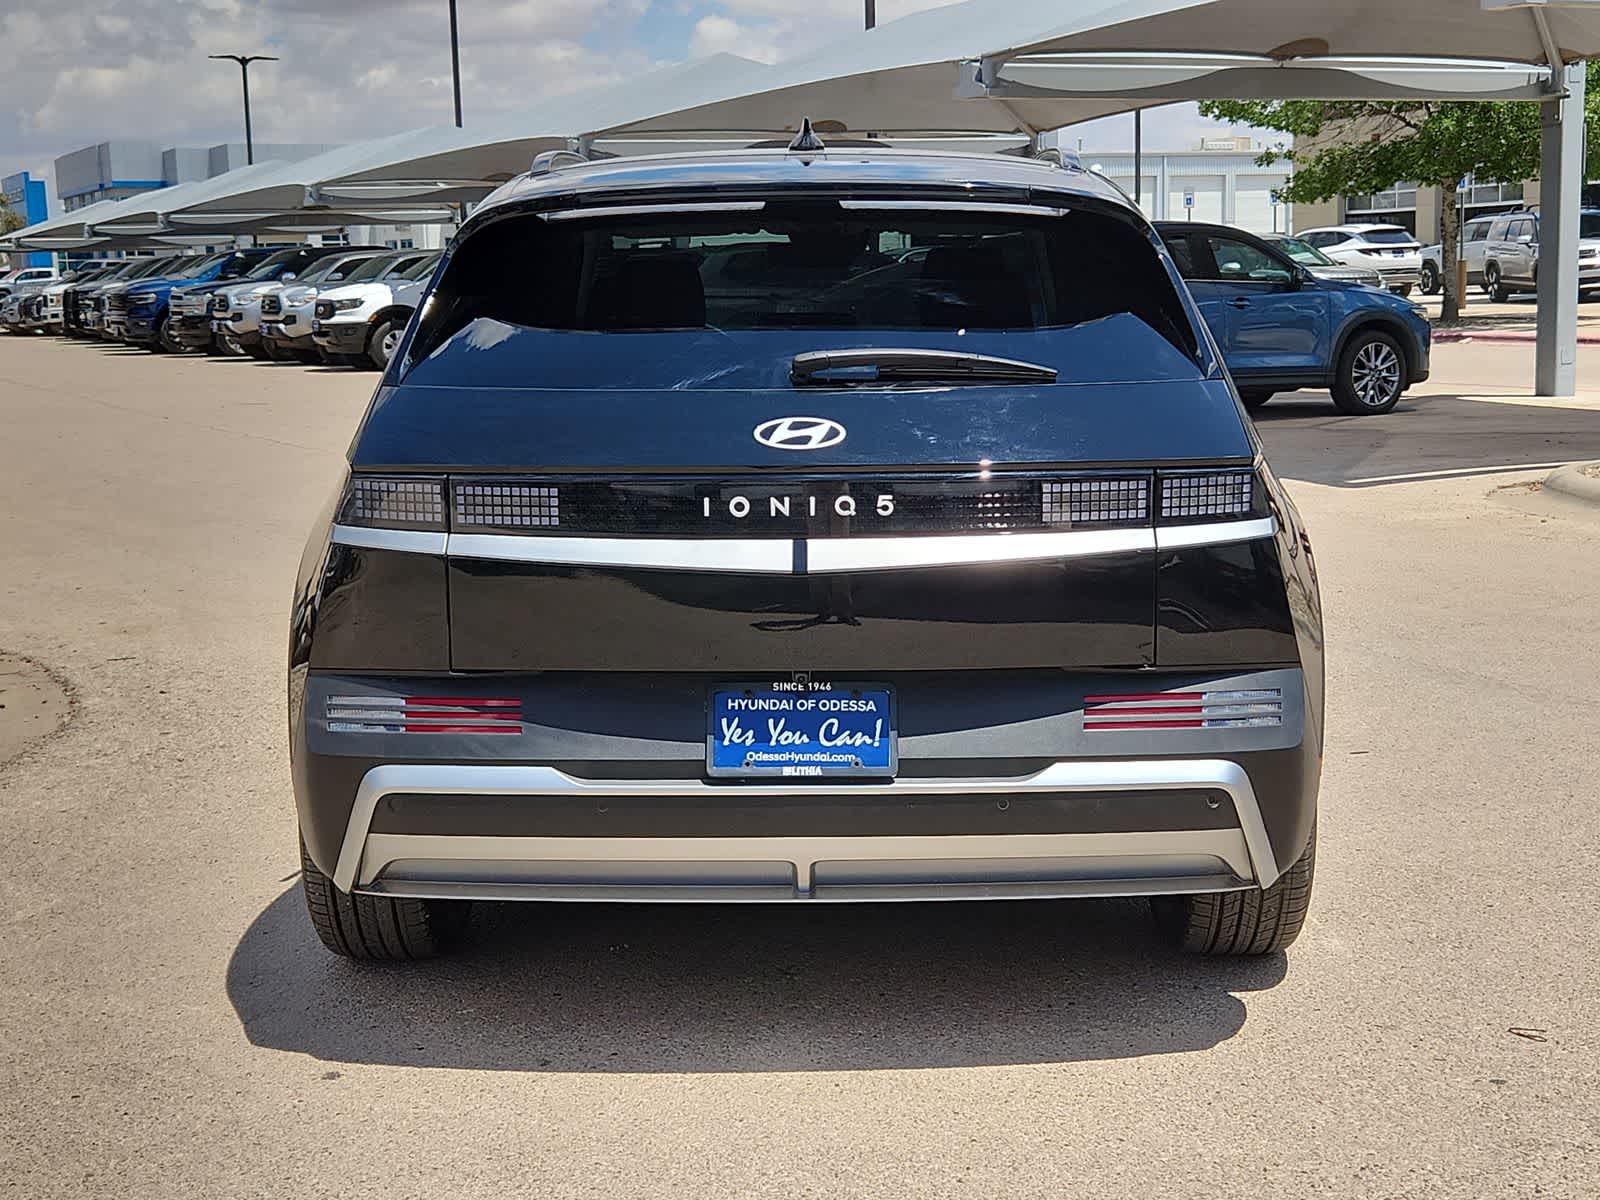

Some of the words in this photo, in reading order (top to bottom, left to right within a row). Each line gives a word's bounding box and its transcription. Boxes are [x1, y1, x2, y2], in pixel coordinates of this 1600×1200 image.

[703, 495, 857, 518] IONIQ
[876, 494, 895, 516] 5
[772, 682, 805, 691] SINCE
[808, 682, 832, 691] 1946
[727, 699, 794, 711] HYUNDAI
[796, 700, 816, 711] OF
[818, 700, 877, 712] ODESSA
[721, 717, 756, 746] Yes
[768, 717, 810, 746] You
[818, 718, 883, 747] Can!
[746, 752, 856, 763] OdessaHyundai.com
